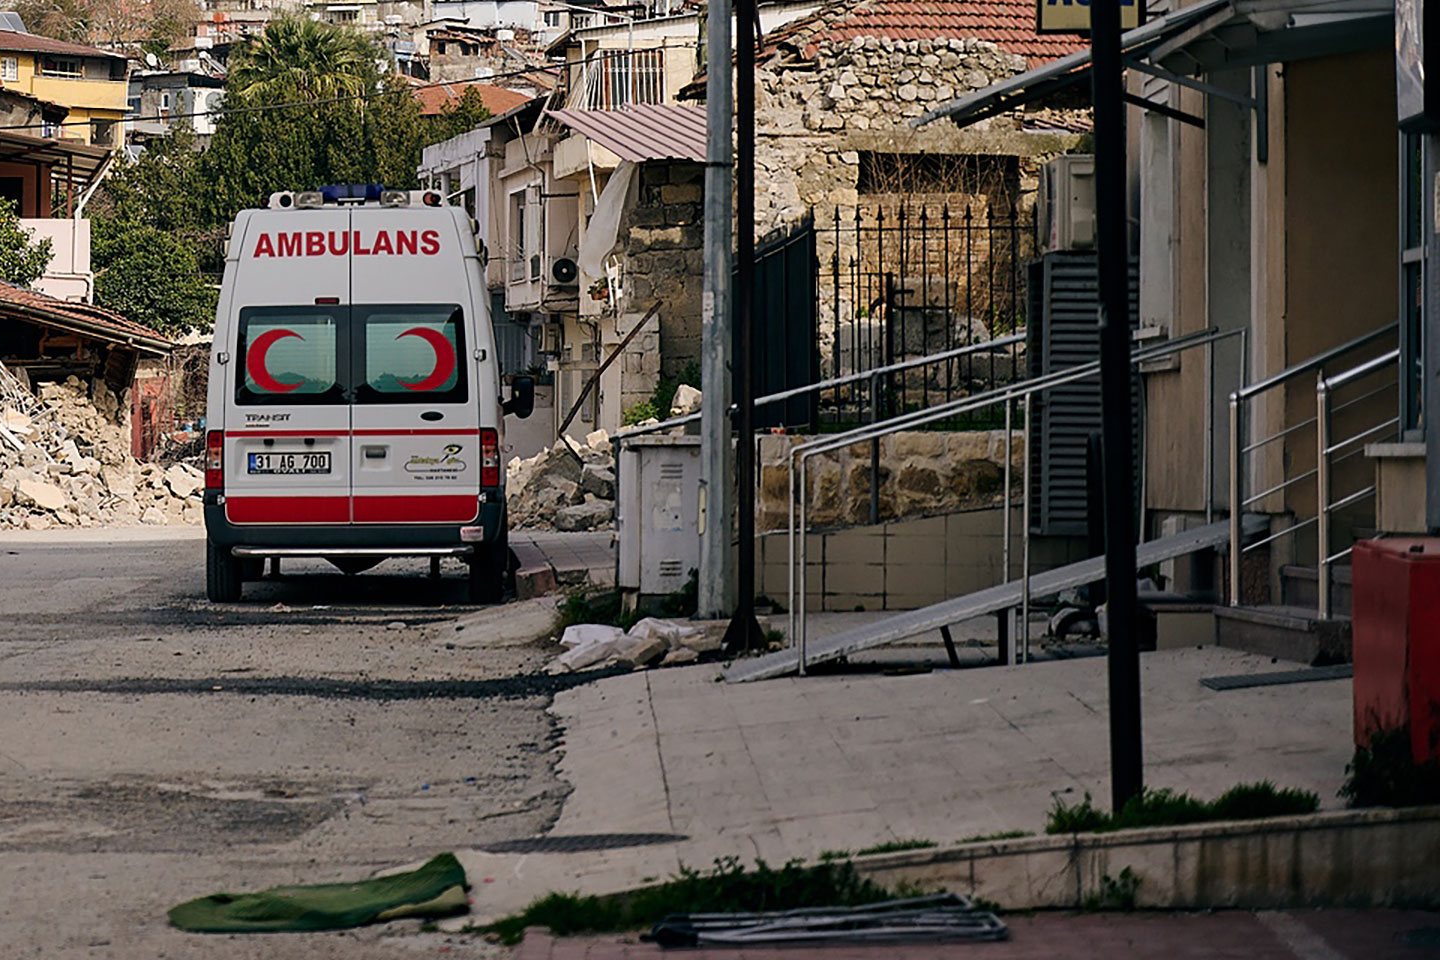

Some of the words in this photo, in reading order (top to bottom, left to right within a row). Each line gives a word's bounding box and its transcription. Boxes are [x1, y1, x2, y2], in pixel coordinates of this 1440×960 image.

[253, 230, 440, 258] AMBULANS
[257, 455, 270, 468] 31
[280, 455, 294, 468] AG
[304, 455, 325, 468] 700
